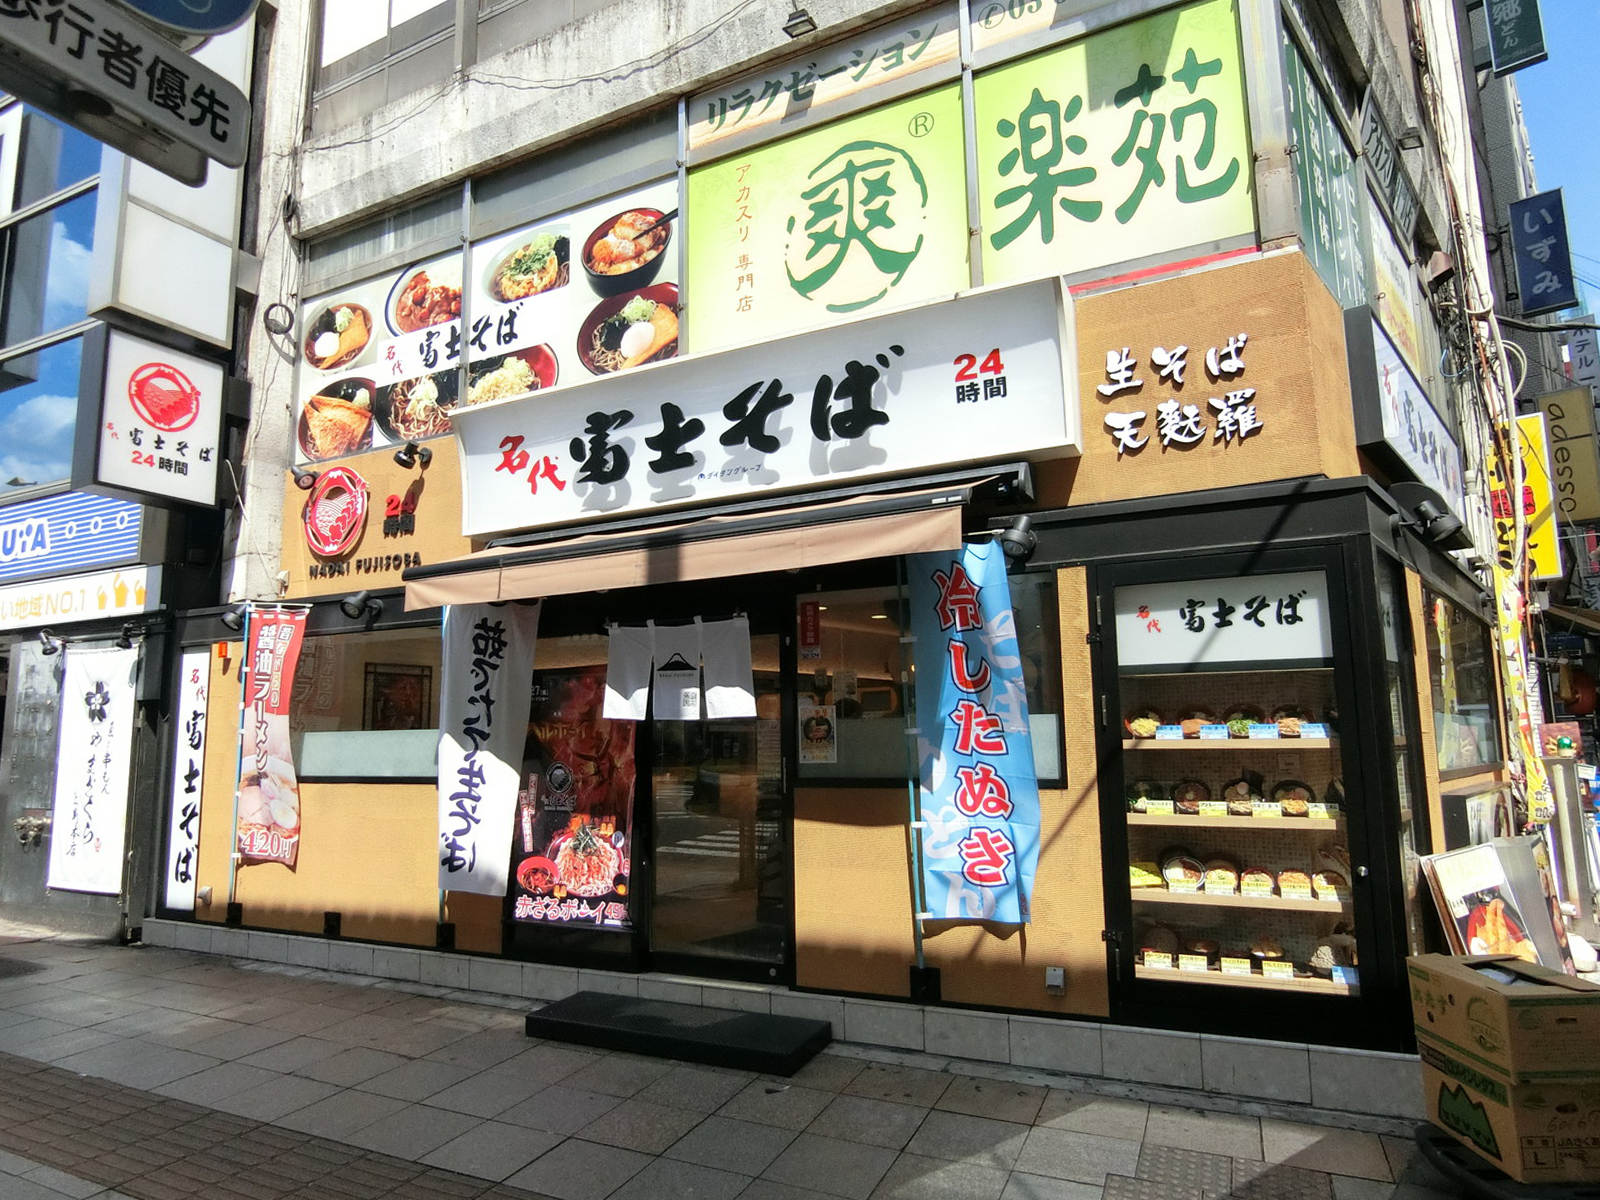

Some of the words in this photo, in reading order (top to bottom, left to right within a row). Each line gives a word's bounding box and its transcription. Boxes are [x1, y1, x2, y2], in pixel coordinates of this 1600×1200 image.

[708, 24, 938, 134] リラクゼーション
[990, 47, 1240, 251] 楽苑
[735, 164, 754, 312] アカスリ専門店
[1523, 208, 1562, 295] いずみ
[418, 301, 525, 370] 富士そば
[953, 348, 1004, 382] 24
[1096, 333, 1248, 396] 生そば
[495, 435, 567, 495] 名代
[569, 345, 905, 485] 富士そば
[955, 376, 1007, 404] 時間
[129, 427, 214, 462] 富士そば
[131, 450, 188, 476] 24時間
[1547, 402, 1593, 513] adesso
[384, 495, 416, 517] 24
[309, 561, 350, 579] NADAI
[356, 552, 422, 574] FUJISOBA
[1136, 605, 1161, 633] 名代
[1179, 590, 1307, 633] 富士そば
[189, 668, 207, 702] 名代
[252, 624, 277, 772] 醤油ラーメン
[931, 561, 1016, 887] 冷したぬき
[174, 709, 206, 884] 富士そば
[242, 830, 292, 858] 420円
[515, 894, 605, 925] 赤ざるボーイ
